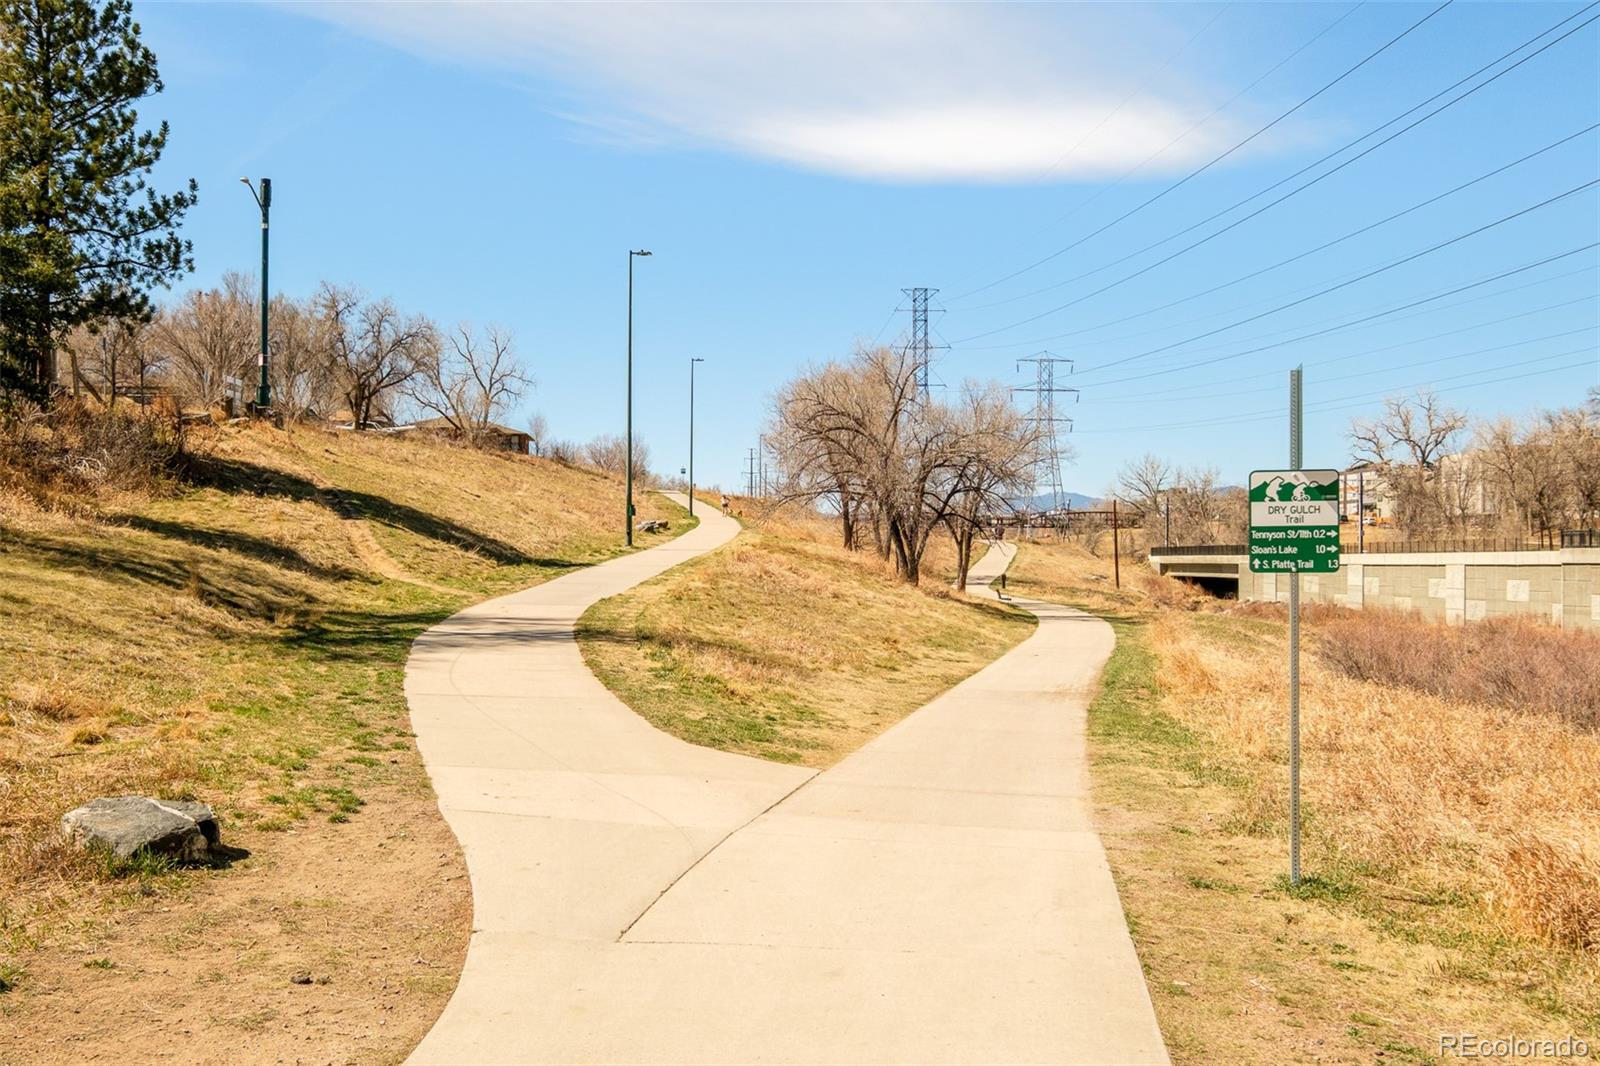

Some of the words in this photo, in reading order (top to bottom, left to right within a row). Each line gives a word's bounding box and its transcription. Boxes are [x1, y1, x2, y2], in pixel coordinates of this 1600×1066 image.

[1268, 506, 1287, 514] DRY
[1290, 506, 1320, 514] GULCH
[1285, 515, 1304, 523] Trail
[1252, 530, 1286, 541] Tennyson
[1251, 546, 1278, 554] Sloan's
[1278, 546, 1298, 554] Lake
[1262, 560, 1270, 568] S.
[1272, 560, 1296, 568] Platte
[1297, 560, 1314, 568] Trail
[1328, 560, 1338, 568] 1.3
